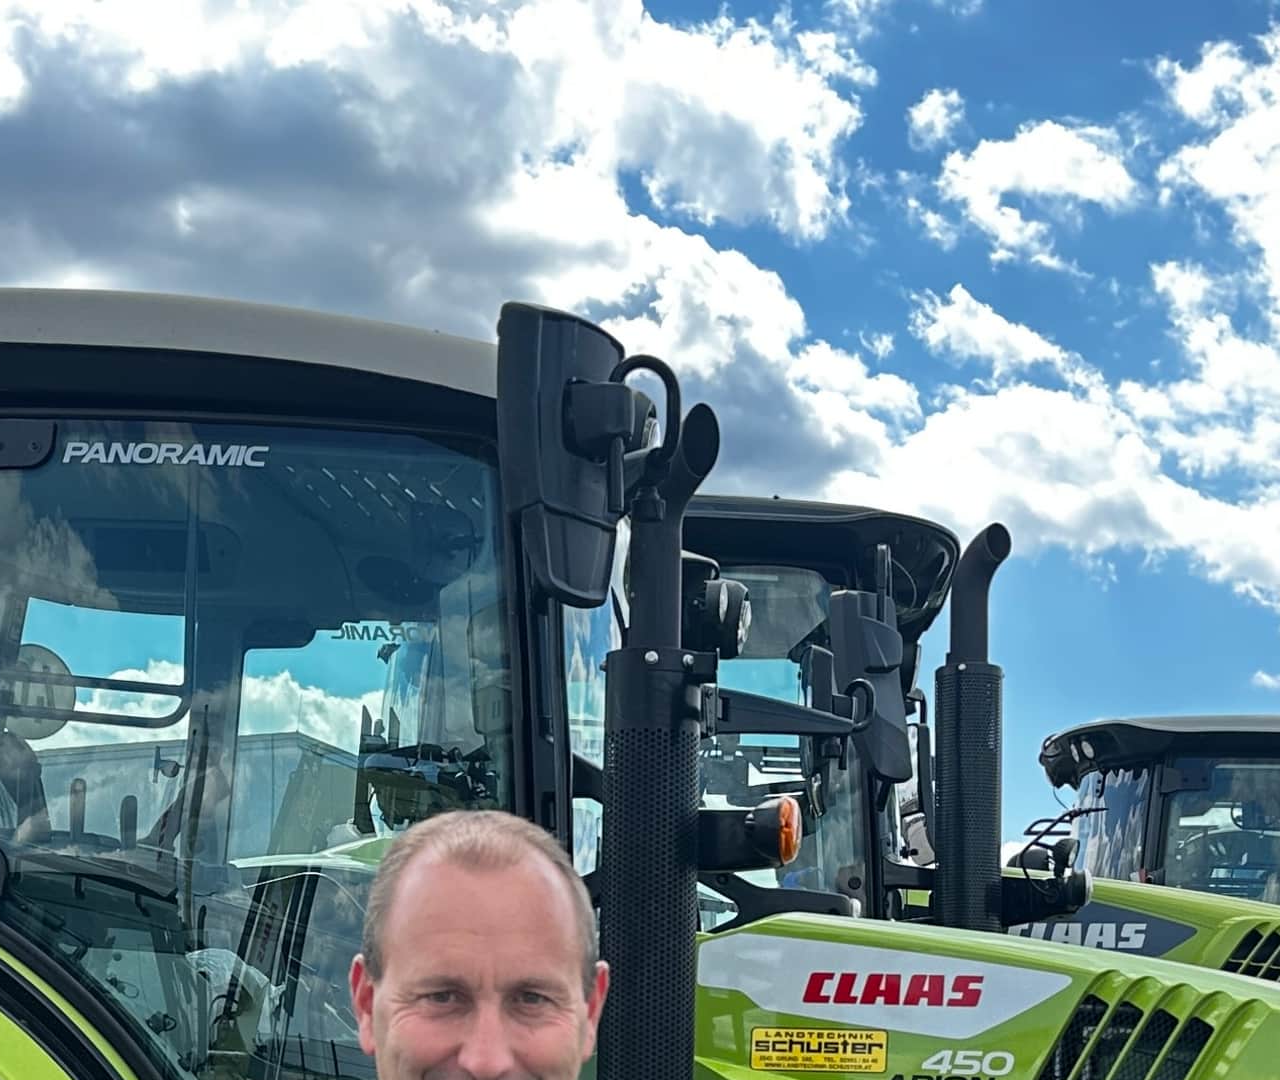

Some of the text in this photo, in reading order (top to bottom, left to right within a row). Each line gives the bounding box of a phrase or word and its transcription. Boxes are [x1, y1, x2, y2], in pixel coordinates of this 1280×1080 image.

[62, 442, 269, 467] PANORAMIC
[802, 971, 984, 1007] CLAAS
[755, 1038, 883, 1054] schuster
[765, 1031, 874, 1040] LANDTECHNIK
[921, 1050, 1015, 1076] 450
